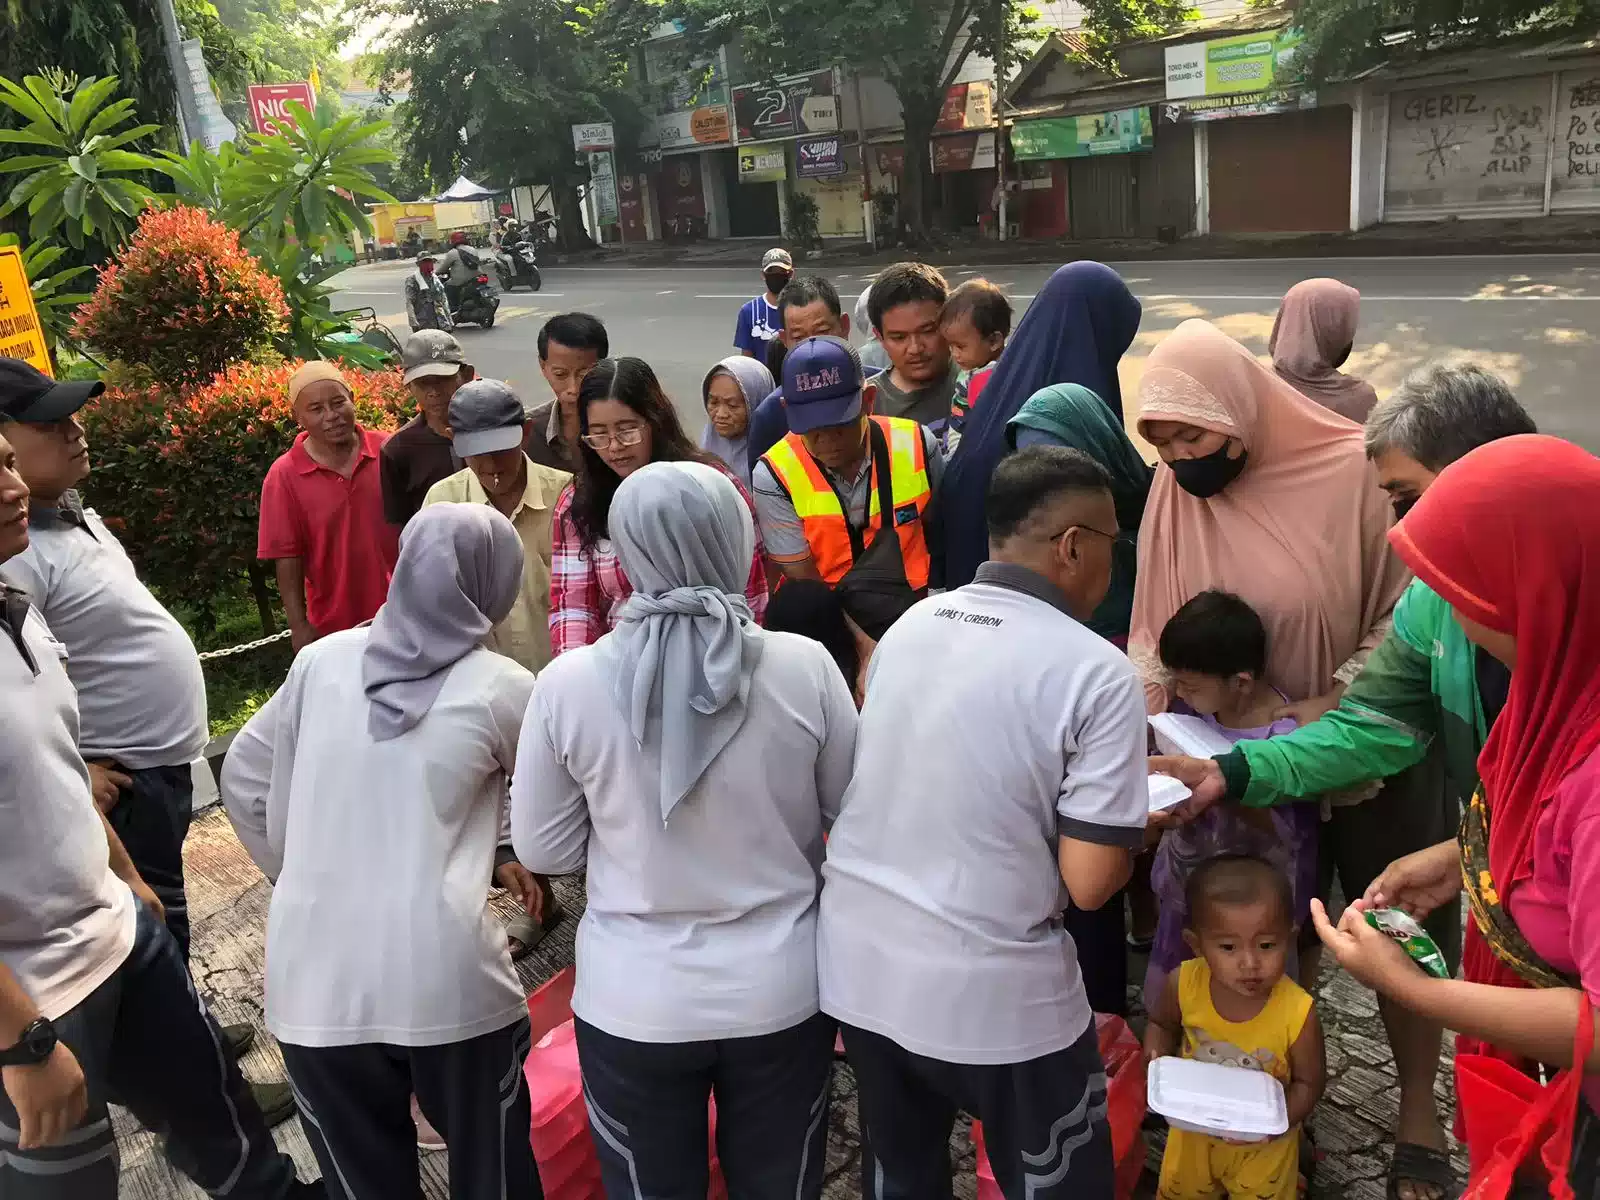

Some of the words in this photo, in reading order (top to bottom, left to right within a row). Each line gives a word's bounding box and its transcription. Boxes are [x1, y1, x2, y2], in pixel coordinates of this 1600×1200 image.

[257, 98, 305, 118] NIC
[14, 313, 36, 334] MOBIL
[934, 607, 958, 620] LAPAS
[964, 614, 1004, 628] CIREBON
